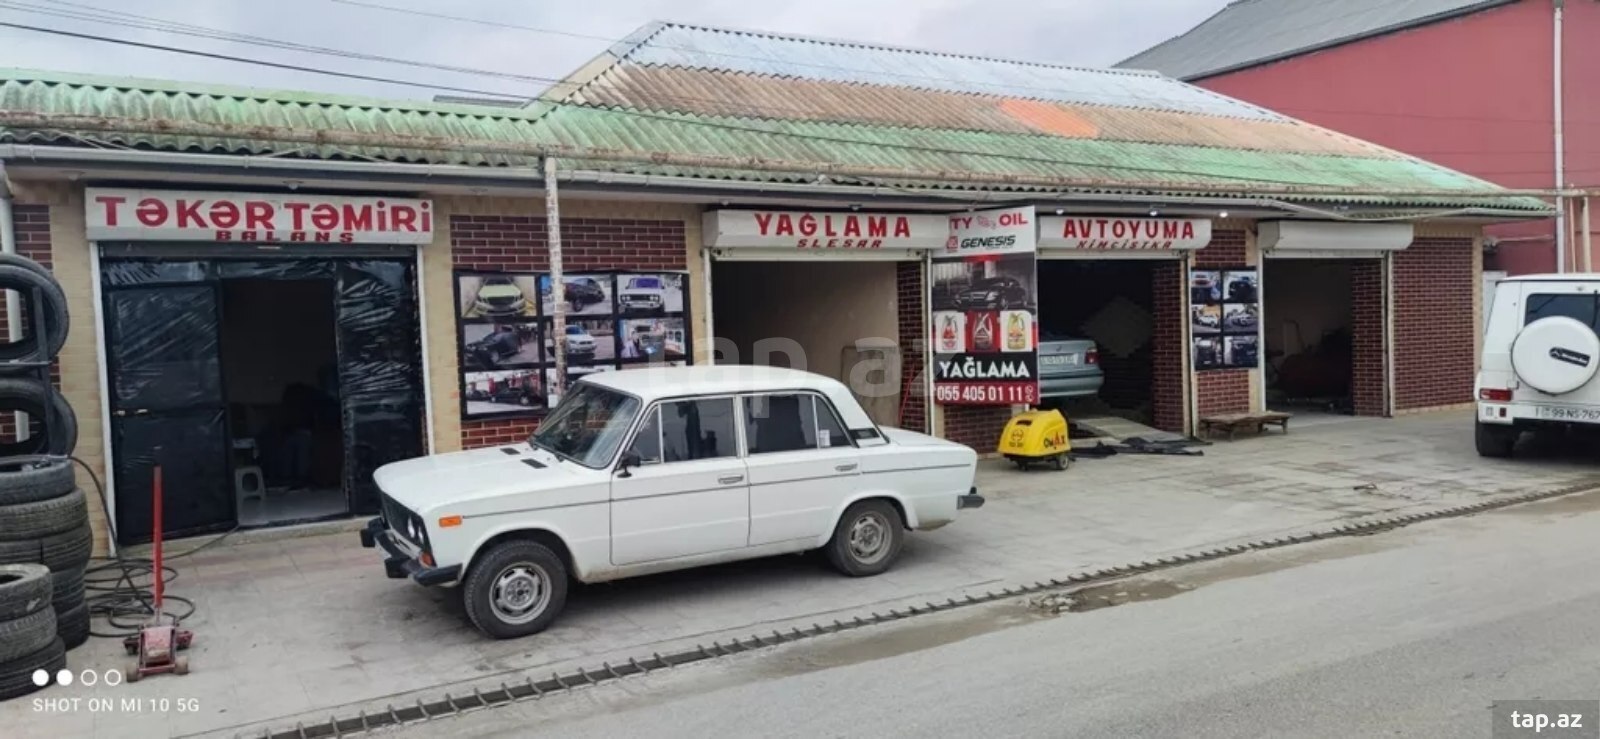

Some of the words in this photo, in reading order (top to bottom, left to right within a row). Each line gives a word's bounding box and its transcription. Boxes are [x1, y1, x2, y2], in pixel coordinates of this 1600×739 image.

[95, 196, 275, 231] TƏKƏR
[949, 217, 973, 230] TY
[999, 212, 1028, 227] OIL
[215, 230, 354, 243] BALANS
[1063, 218, 1195, 240] AVTOYUMA
[797, 238, 883, 249] SLESAR
[961, 235, 1016, 249] GENESIS
[939, 356, 1031, 378] YAĞLAMA
[937, 385, 960, 401] 055
[962, 385, 986, 401] 405
[988, 385, 1005, 401] 01
[1008, 385, 1023, 401] 11
